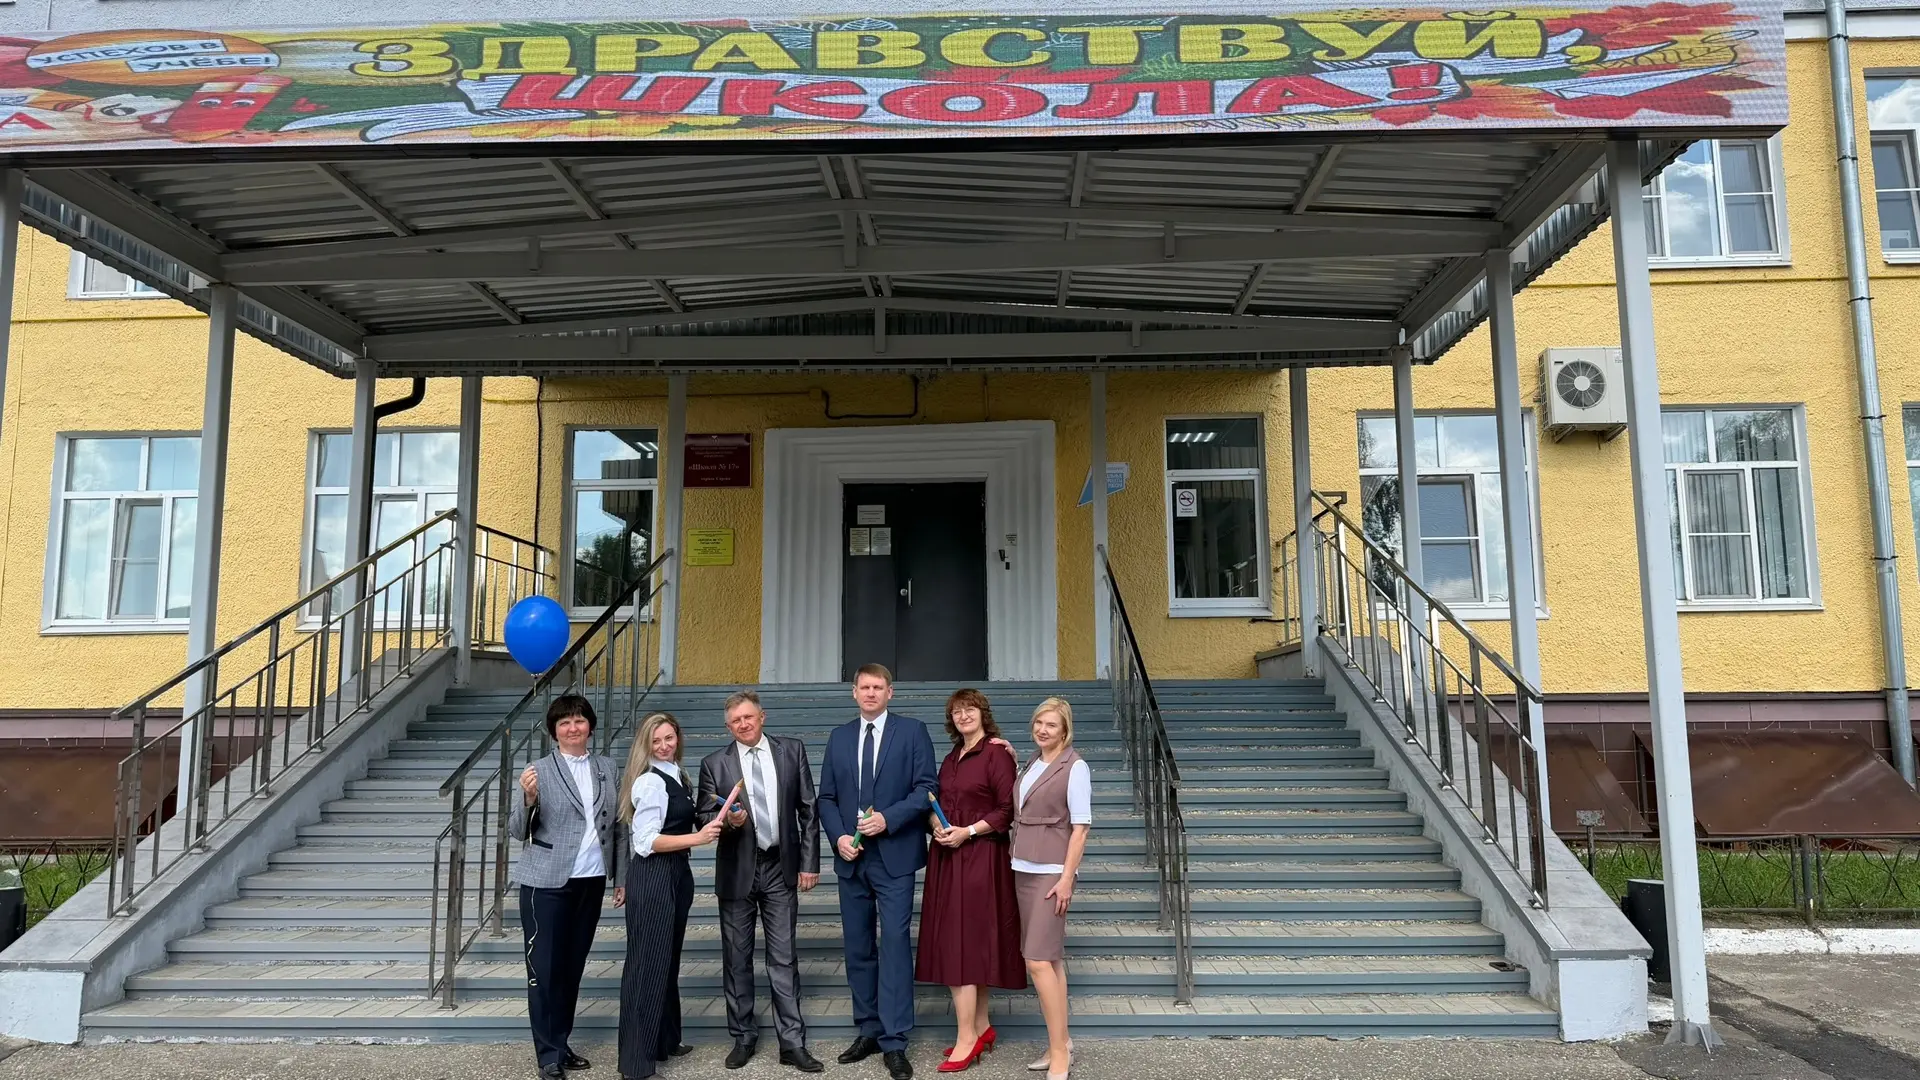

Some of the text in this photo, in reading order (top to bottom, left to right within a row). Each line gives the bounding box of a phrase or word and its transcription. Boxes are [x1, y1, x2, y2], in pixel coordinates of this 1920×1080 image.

[32, 42, 220, 64] УСПЕХОВ В
[139, 56, 272, 71] УЧЁБЕ!
[350, 11, 1606, 79] ЗДРАВСТВУЙ,
[500, 62, 1444, 122] ШКОЛА!
